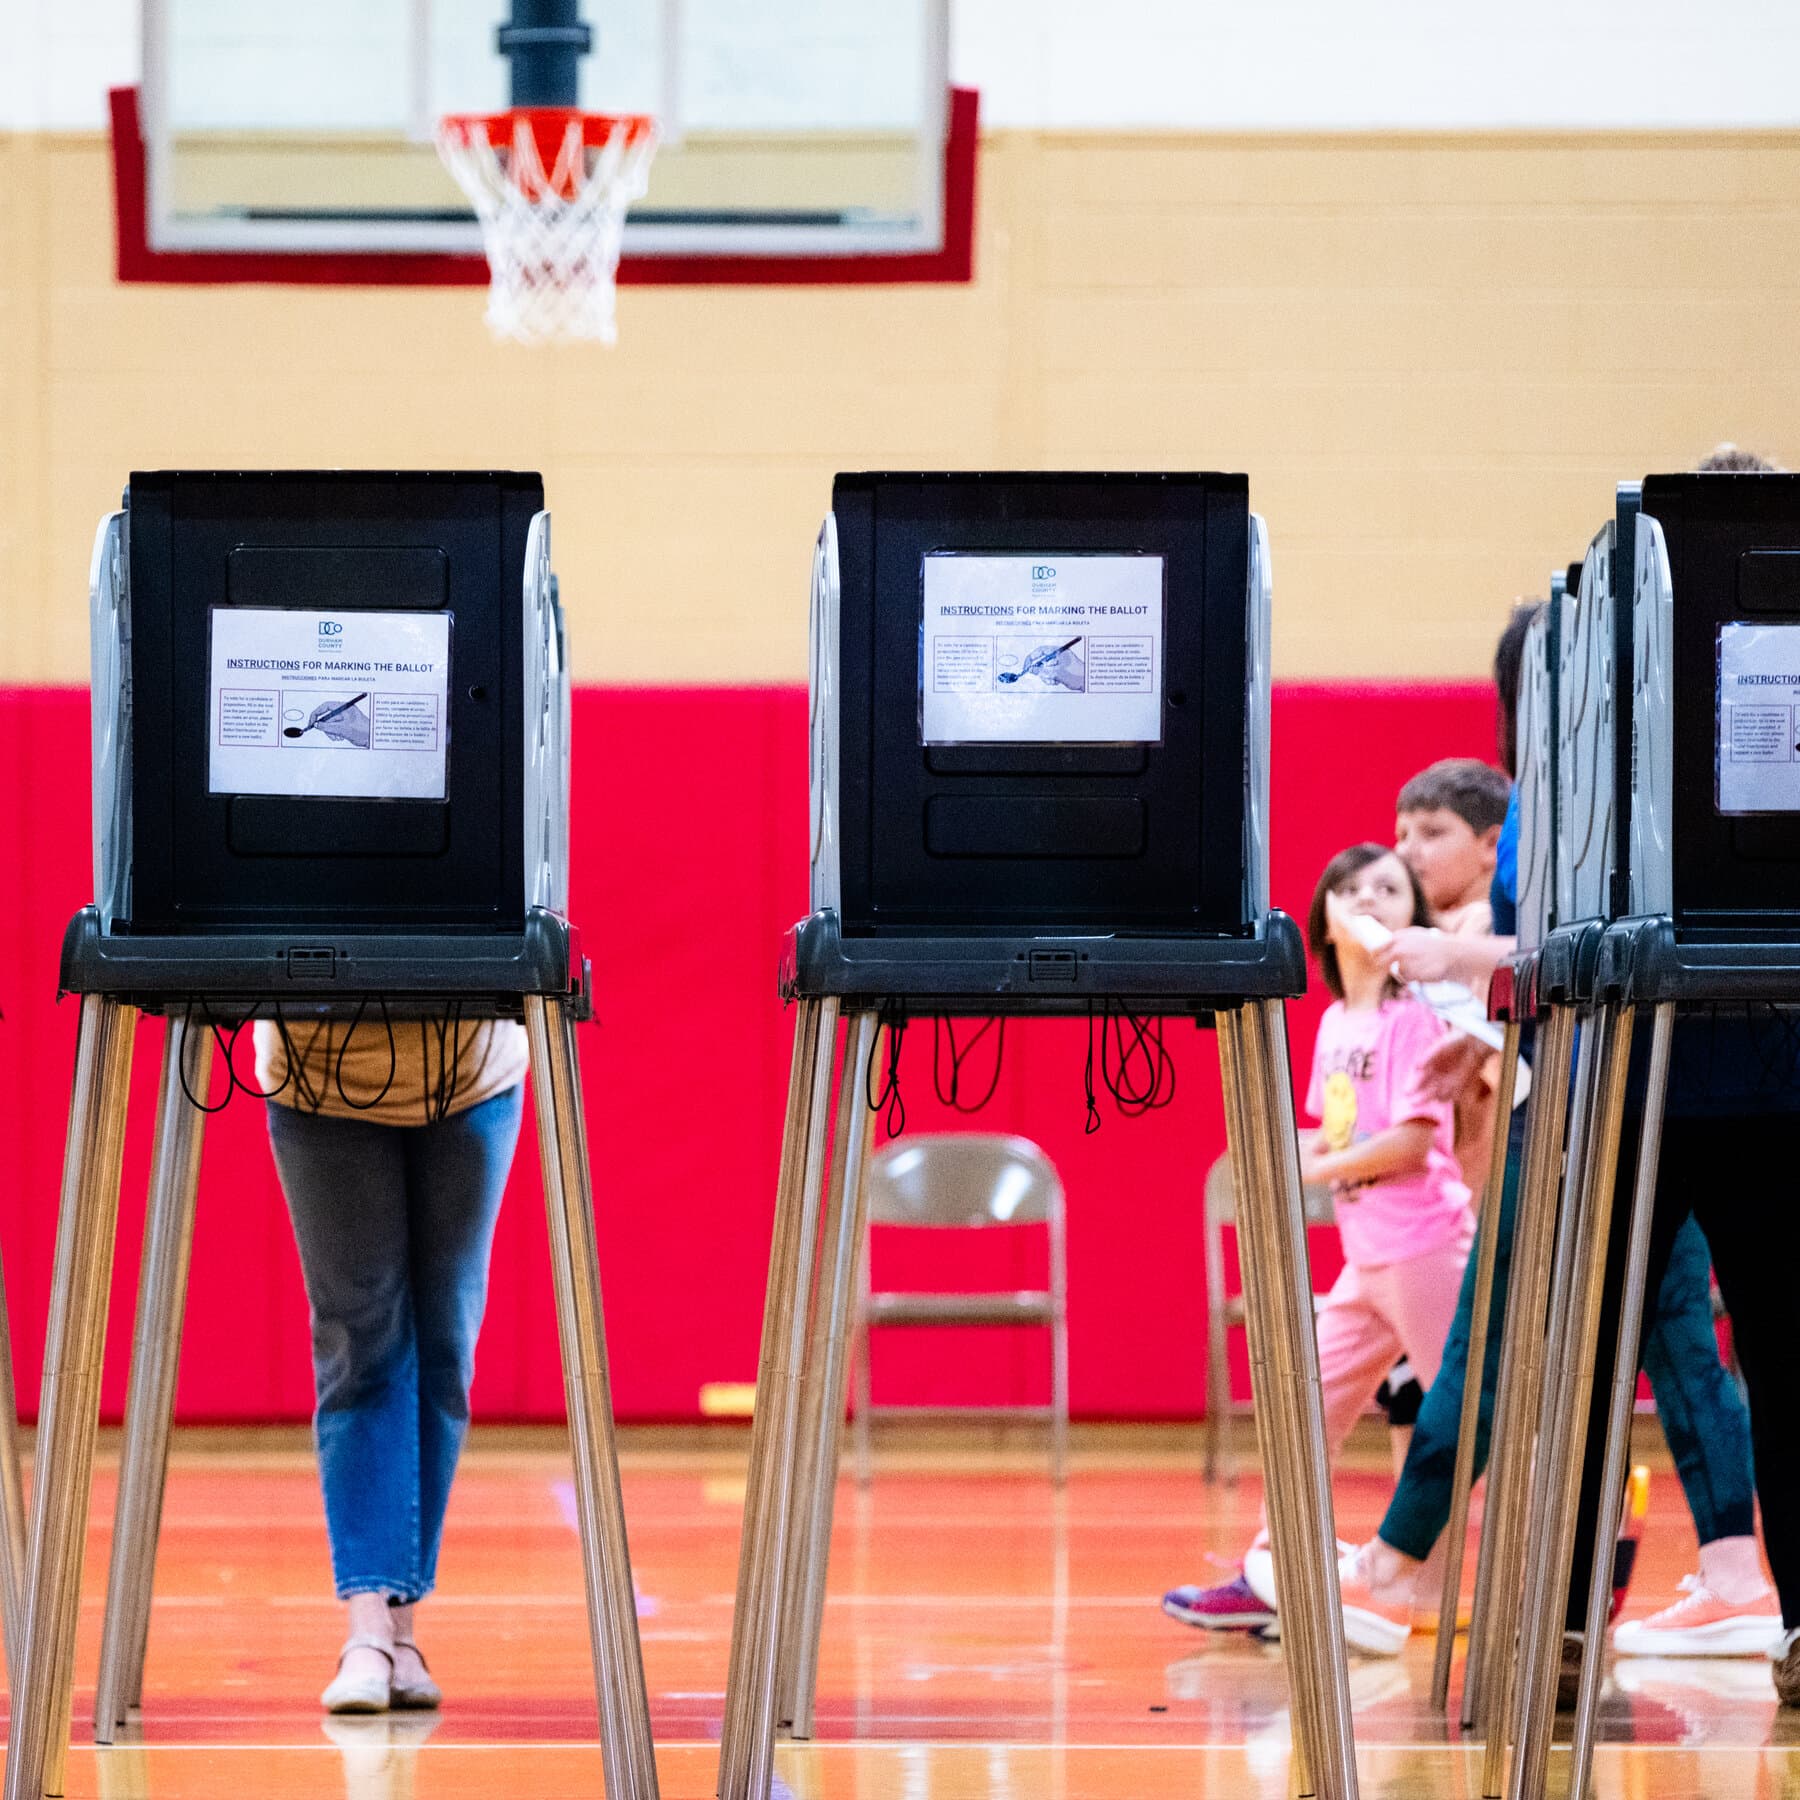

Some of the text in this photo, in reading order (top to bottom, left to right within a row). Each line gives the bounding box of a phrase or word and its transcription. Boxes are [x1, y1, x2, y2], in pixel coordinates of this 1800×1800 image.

[940, 606, 1148, 616] INSTRUCTIONS FOR MARKING THE BALLOT
[227, 659, 434, 672] INSTRUCTIONS FOR MARKING THE BALLOT
[1737, 675, 1800, 685] INSTRUCTIO
